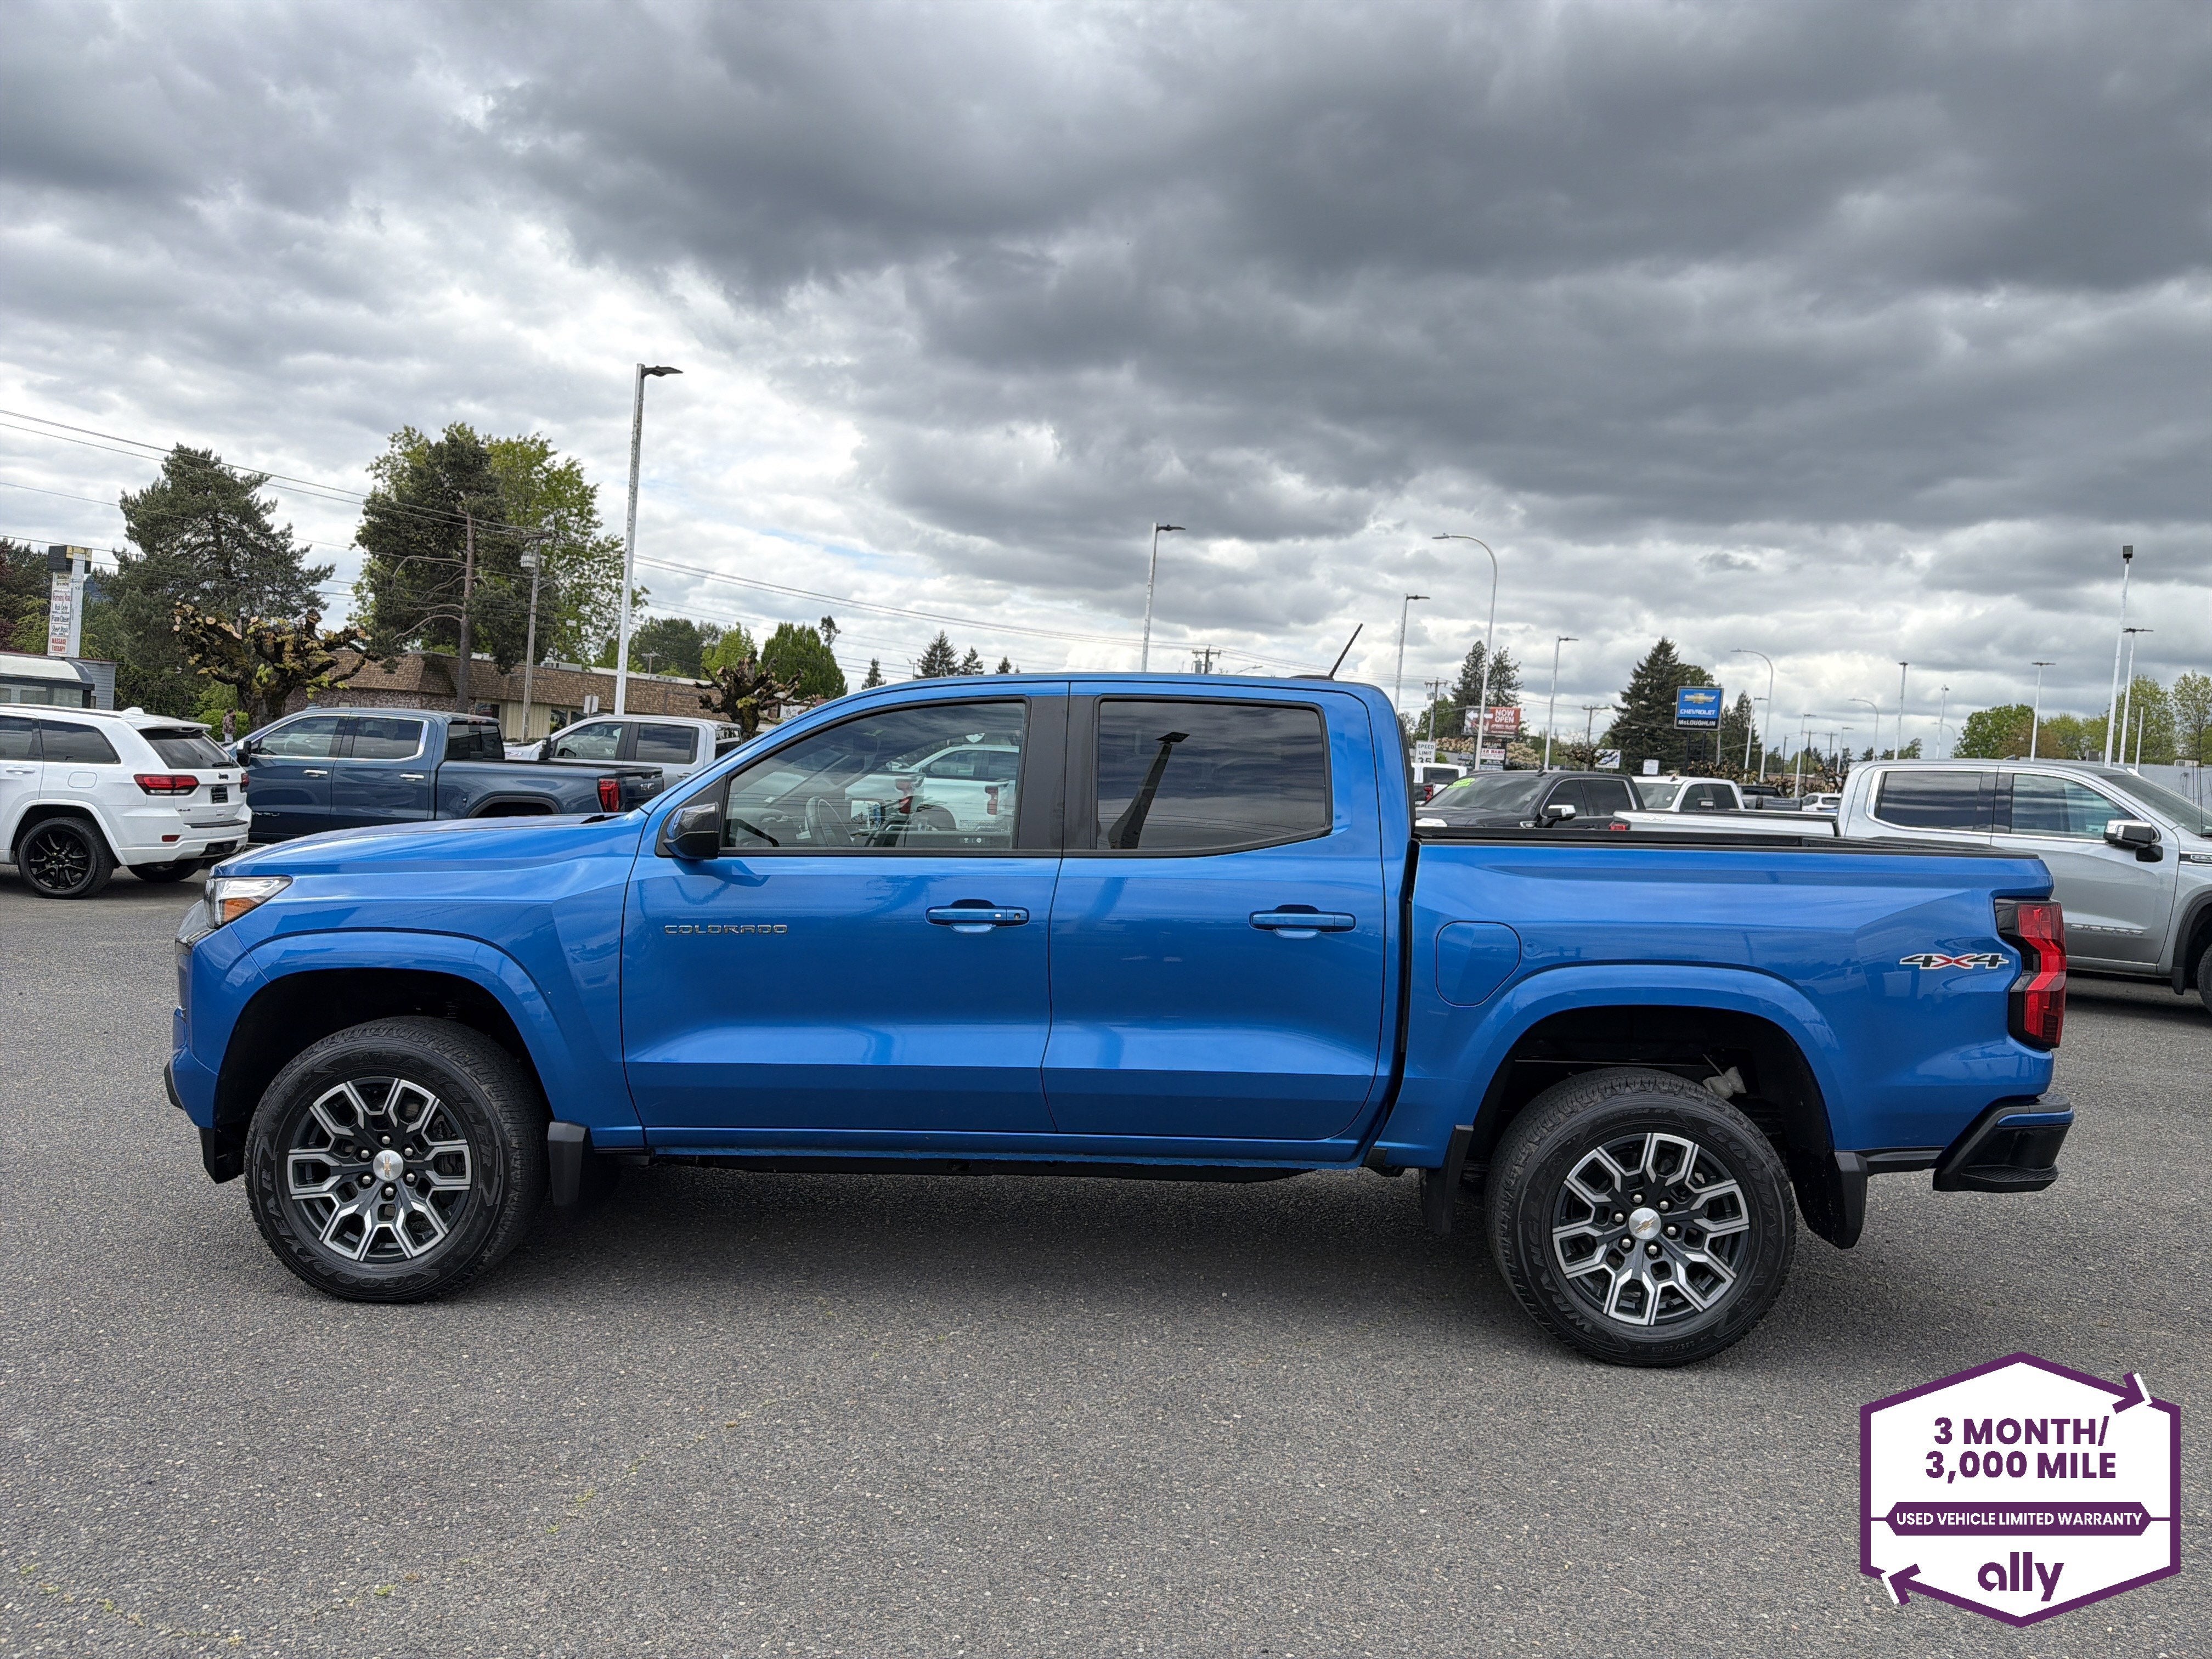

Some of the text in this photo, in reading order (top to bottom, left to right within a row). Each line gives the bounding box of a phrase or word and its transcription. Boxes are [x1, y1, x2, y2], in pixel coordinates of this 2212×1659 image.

[1495, 709, 1514, 717] NOW
[664, 925, 788, 934] COLORADO
[2070, 924, 2143, 935] SIERRA
[261, 1169, 414, 1288] GOODYEAR
